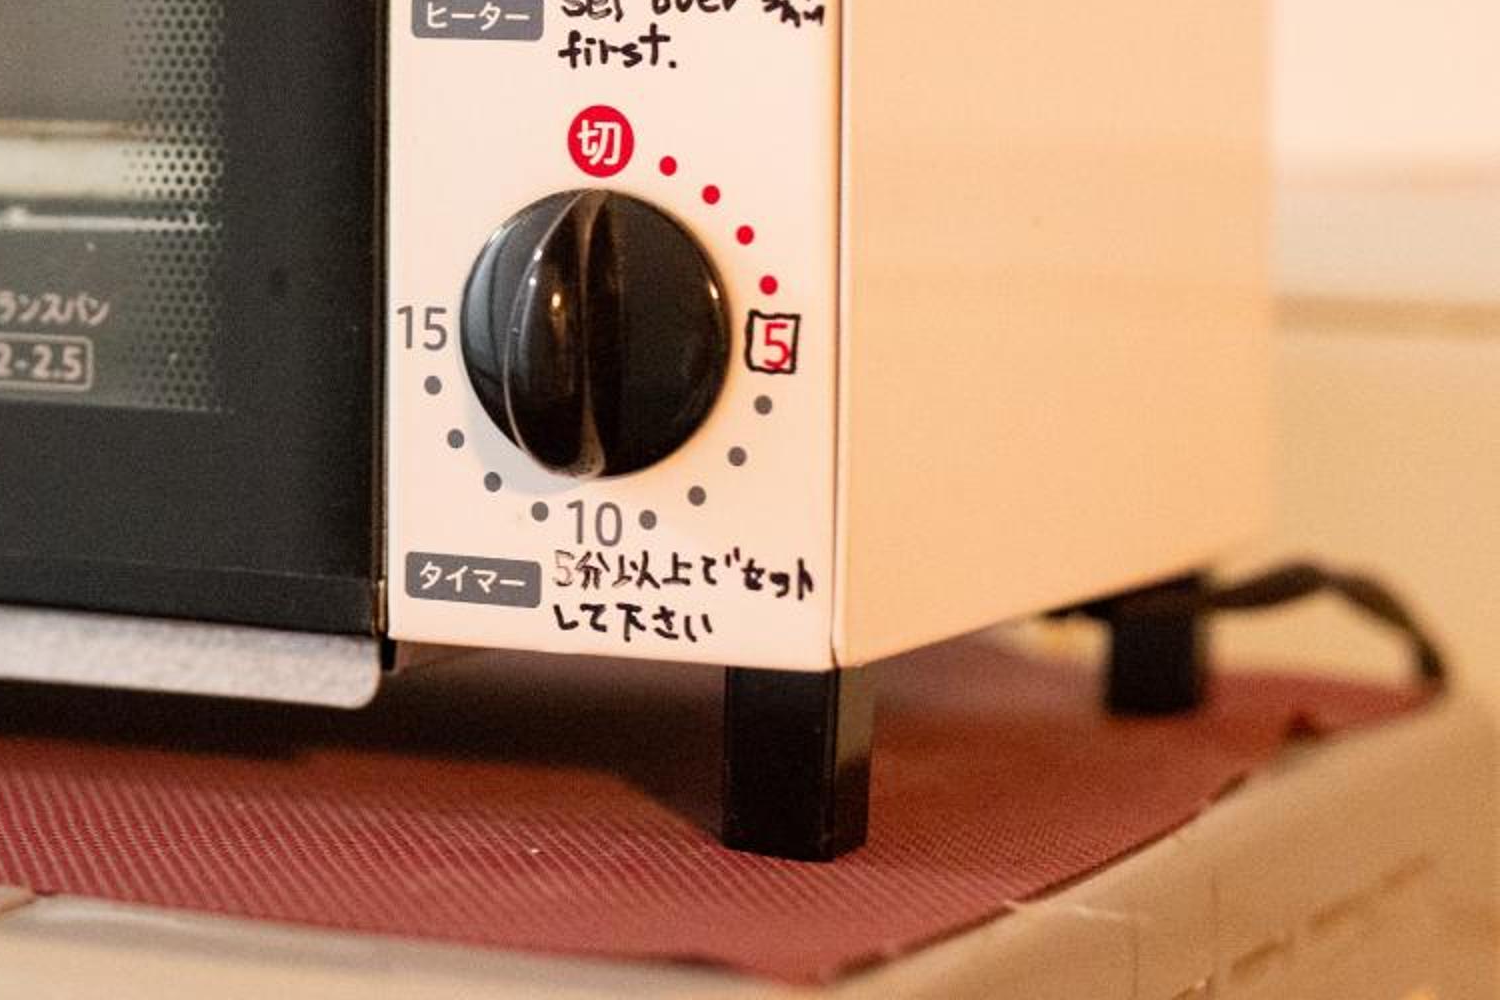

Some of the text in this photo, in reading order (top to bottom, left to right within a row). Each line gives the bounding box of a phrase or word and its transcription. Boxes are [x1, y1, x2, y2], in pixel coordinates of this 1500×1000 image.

[425, 1, 531, 31] ヒーター
[557, 22, 678, 69] first.
[576, 119, 623, 166] 切
[397, 305, 449, 350] 15
[763, 322, 792, 369] 5
[566, 500, 622, 547] 10
[419, 562, 527, 594] タイマー
[553, 603, 714, 643] して下さい
